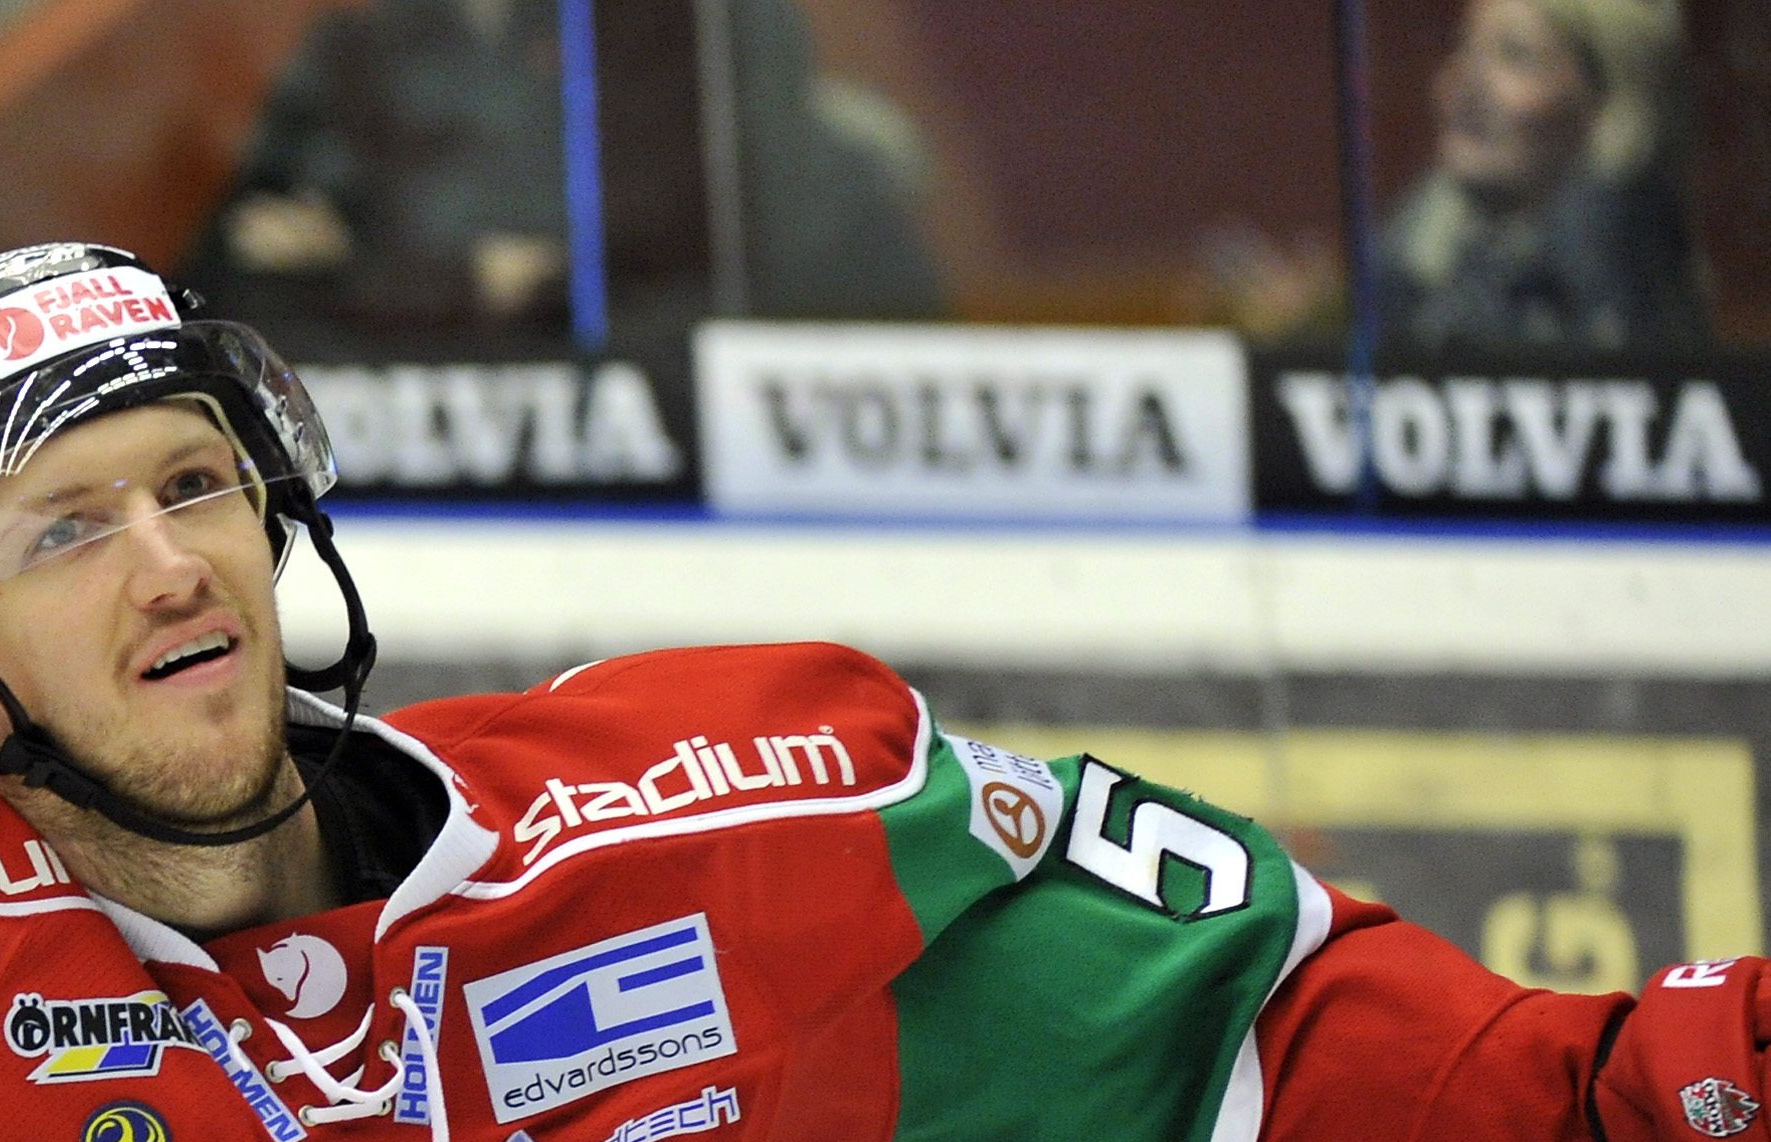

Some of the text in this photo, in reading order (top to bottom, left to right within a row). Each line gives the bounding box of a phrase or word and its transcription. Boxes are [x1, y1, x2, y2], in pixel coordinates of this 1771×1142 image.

[316, 364, 683, 486] OLVIA
[750, 375, 1195, 480] VOLVIA
[1273, 370, 1765, 500] VOLVIA
[513, 735, 857, 867] stadium
[10, 996, 202, 1052] ÖRNFRA
[503, 1026, 723, 1109] edvardssons
